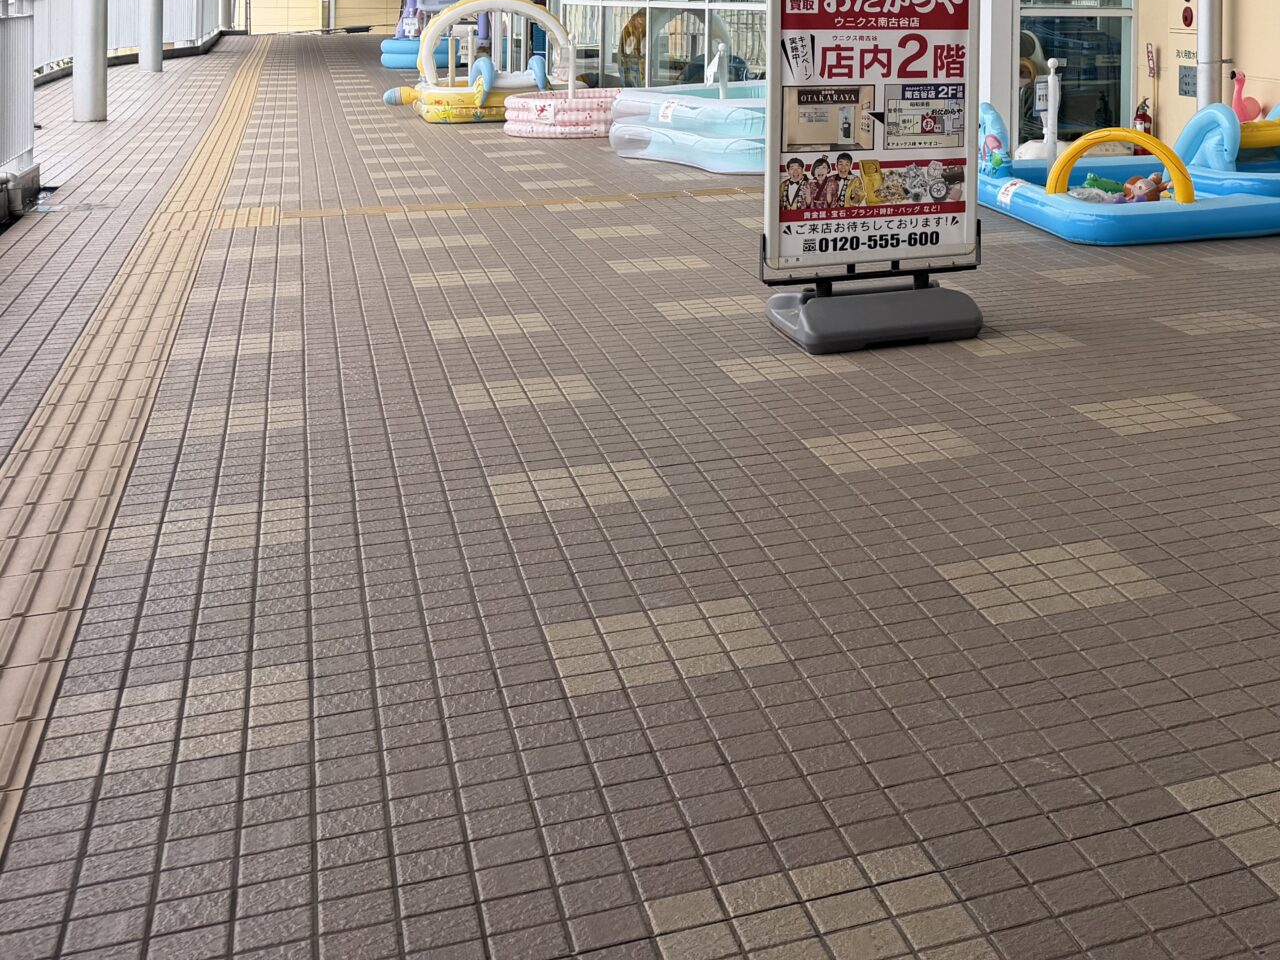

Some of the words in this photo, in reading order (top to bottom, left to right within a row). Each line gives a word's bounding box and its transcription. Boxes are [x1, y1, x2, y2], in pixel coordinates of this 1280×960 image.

[789, 0, 815, 11] 買取
[834, 17, 920, 28] ウニクス南古谷店
[798, 36, 812, 81] キャンペーン
[819, 33, 966, 79] 店内2階
[801, 94, 856, 102] OTAKARAYA
[938, 86, 957, 98] 2F
[818, 230, 940, 253] 0120-555-600
